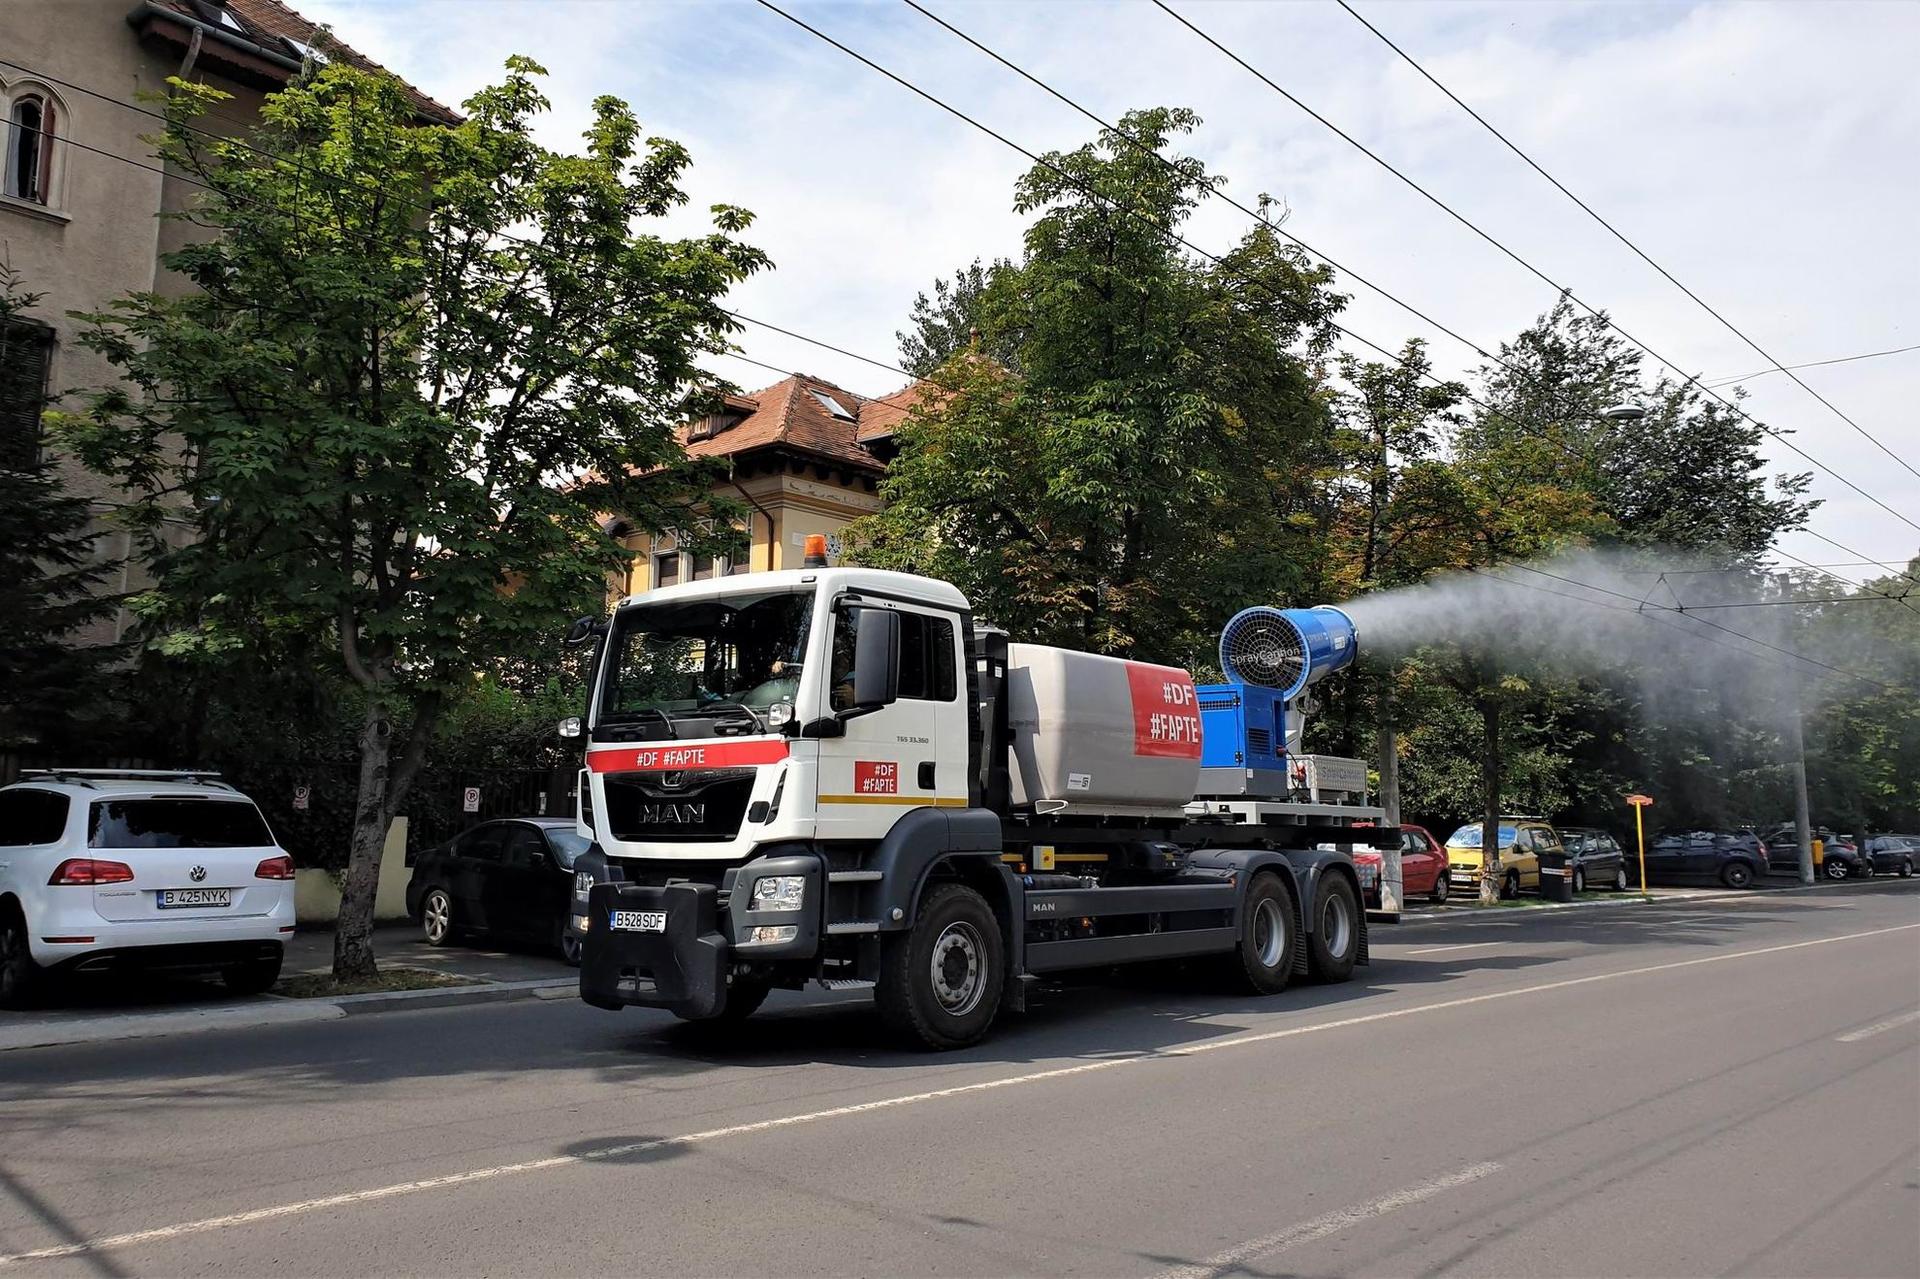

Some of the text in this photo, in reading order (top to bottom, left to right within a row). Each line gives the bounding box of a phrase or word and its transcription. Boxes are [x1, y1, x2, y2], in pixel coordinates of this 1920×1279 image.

[1229, 647, 1301, 665] SprayCannon
[1163, 682, 1193, 706] #DF
[1150, 713, 1199, 743] #FAPTE
[636, 749, 705, 767] #DF #FAPTE
[874, 764, 894, 776] #DF
[863, 778, 894, 792] #FAPTE
[638, 803, 705, 824] MAN
[165, 890, 227, 904] B 425NYK
[1032, 903, 1055, 912] MAN
